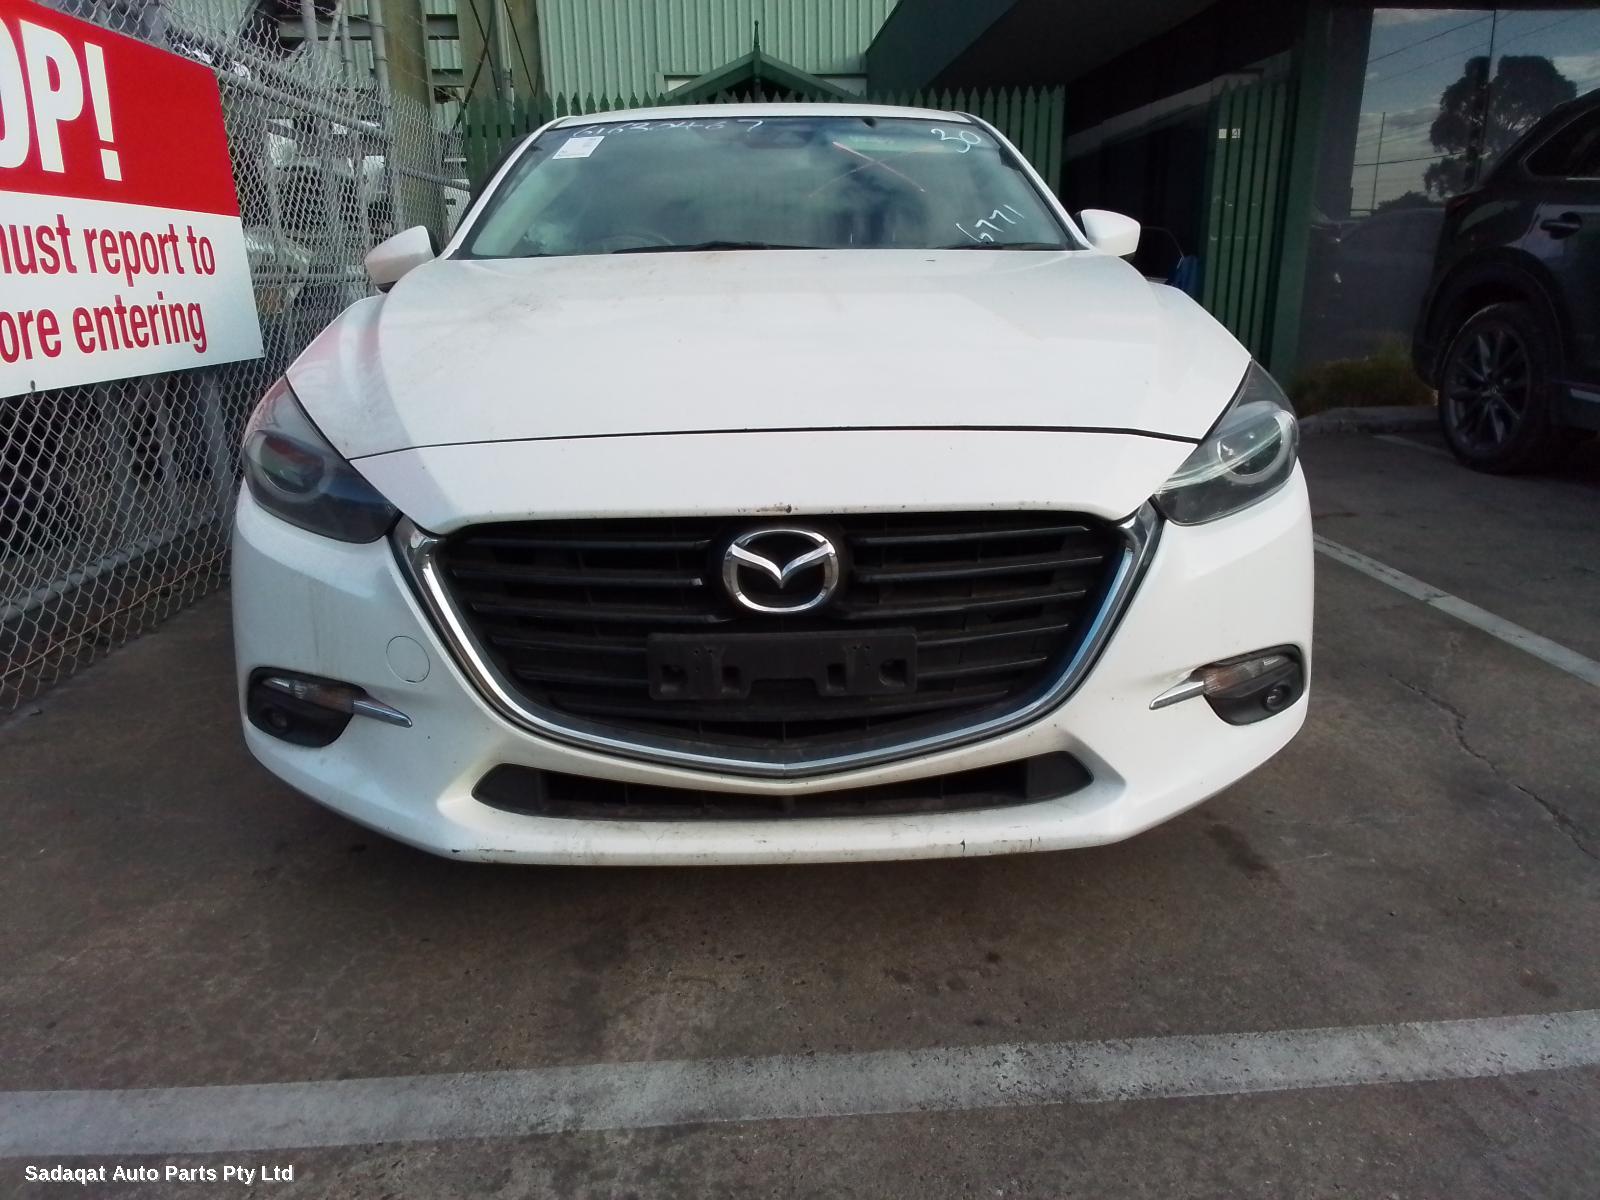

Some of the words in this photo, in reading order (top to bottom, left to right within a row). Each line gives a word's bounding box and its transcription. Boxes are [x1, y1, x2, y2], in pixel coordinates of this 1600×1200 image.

[83, 223, 185, 288] report
[186, 225, 216, 276] to
[72, 290, 208, 354] entering
